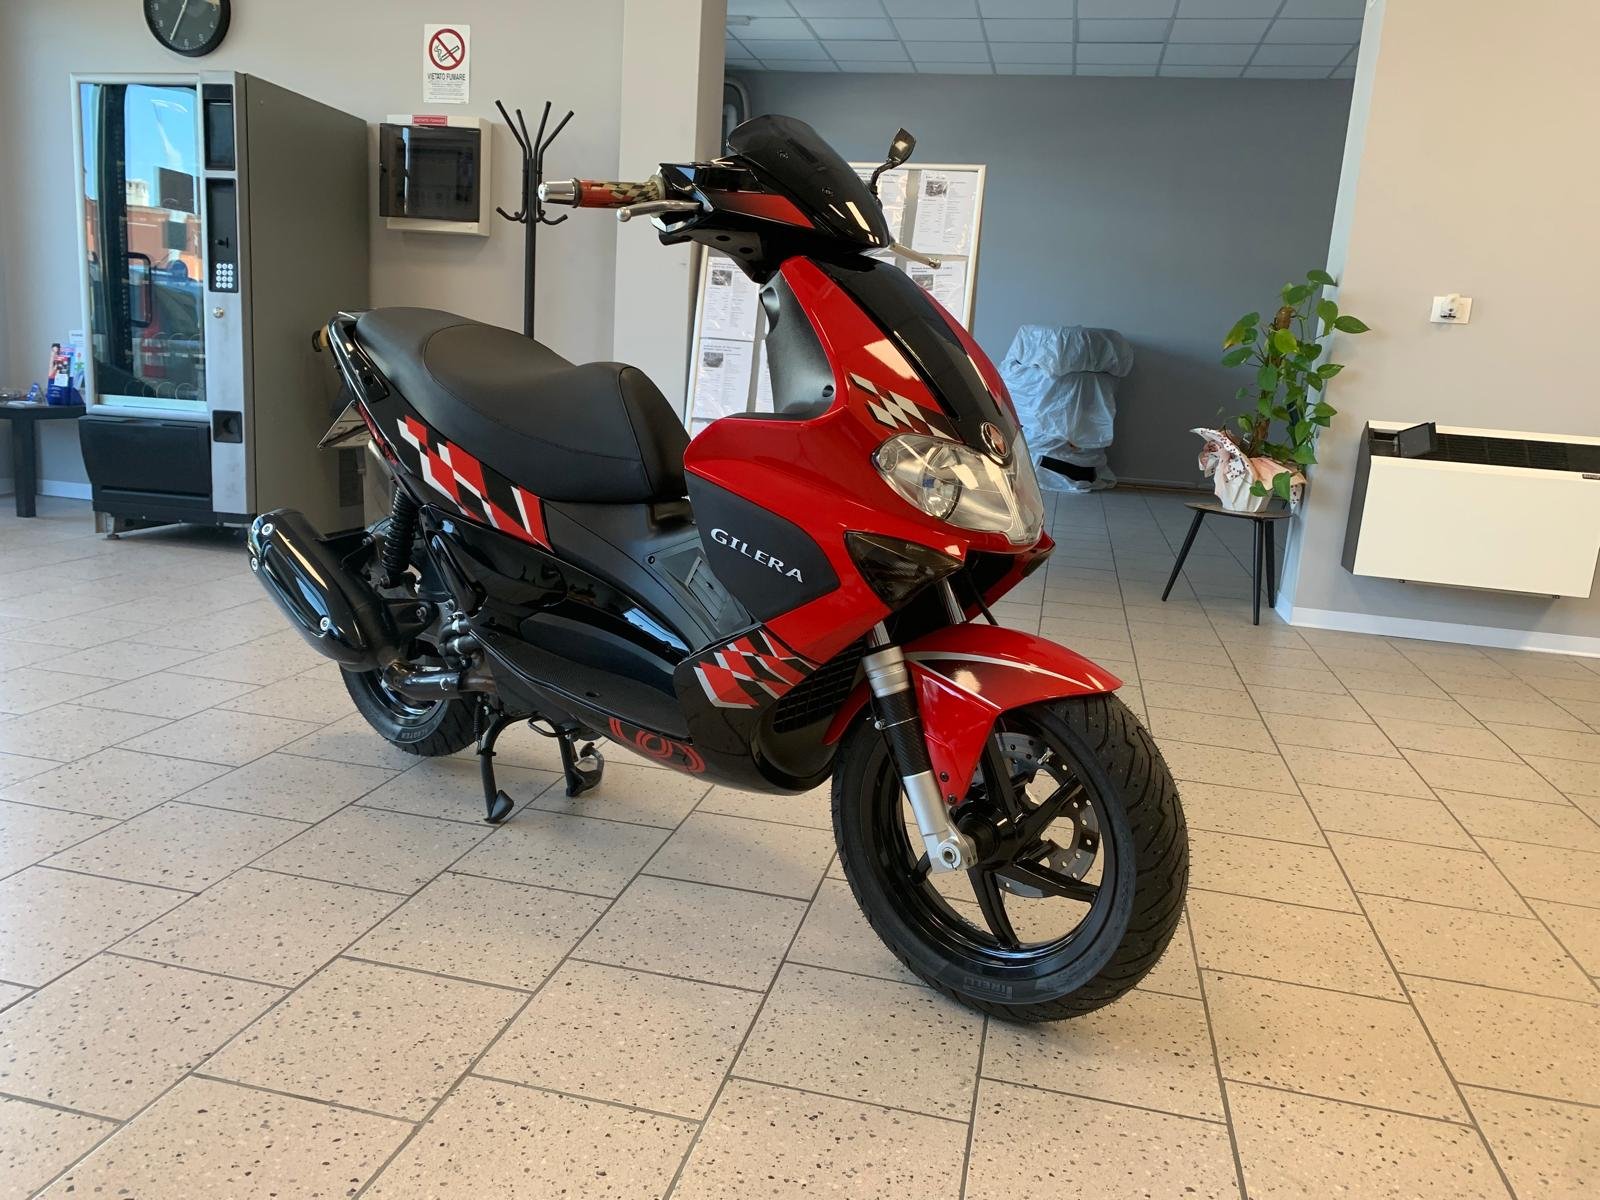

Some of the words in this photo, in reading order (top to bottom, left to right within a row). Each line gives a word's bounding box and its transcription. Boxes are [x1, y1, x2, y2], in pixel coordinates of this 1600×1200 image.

[427, 72, 445, 81] VIETATO
[446, 73, 466, 81] FUMARE
[710, 528, 803, 583] GILERA
